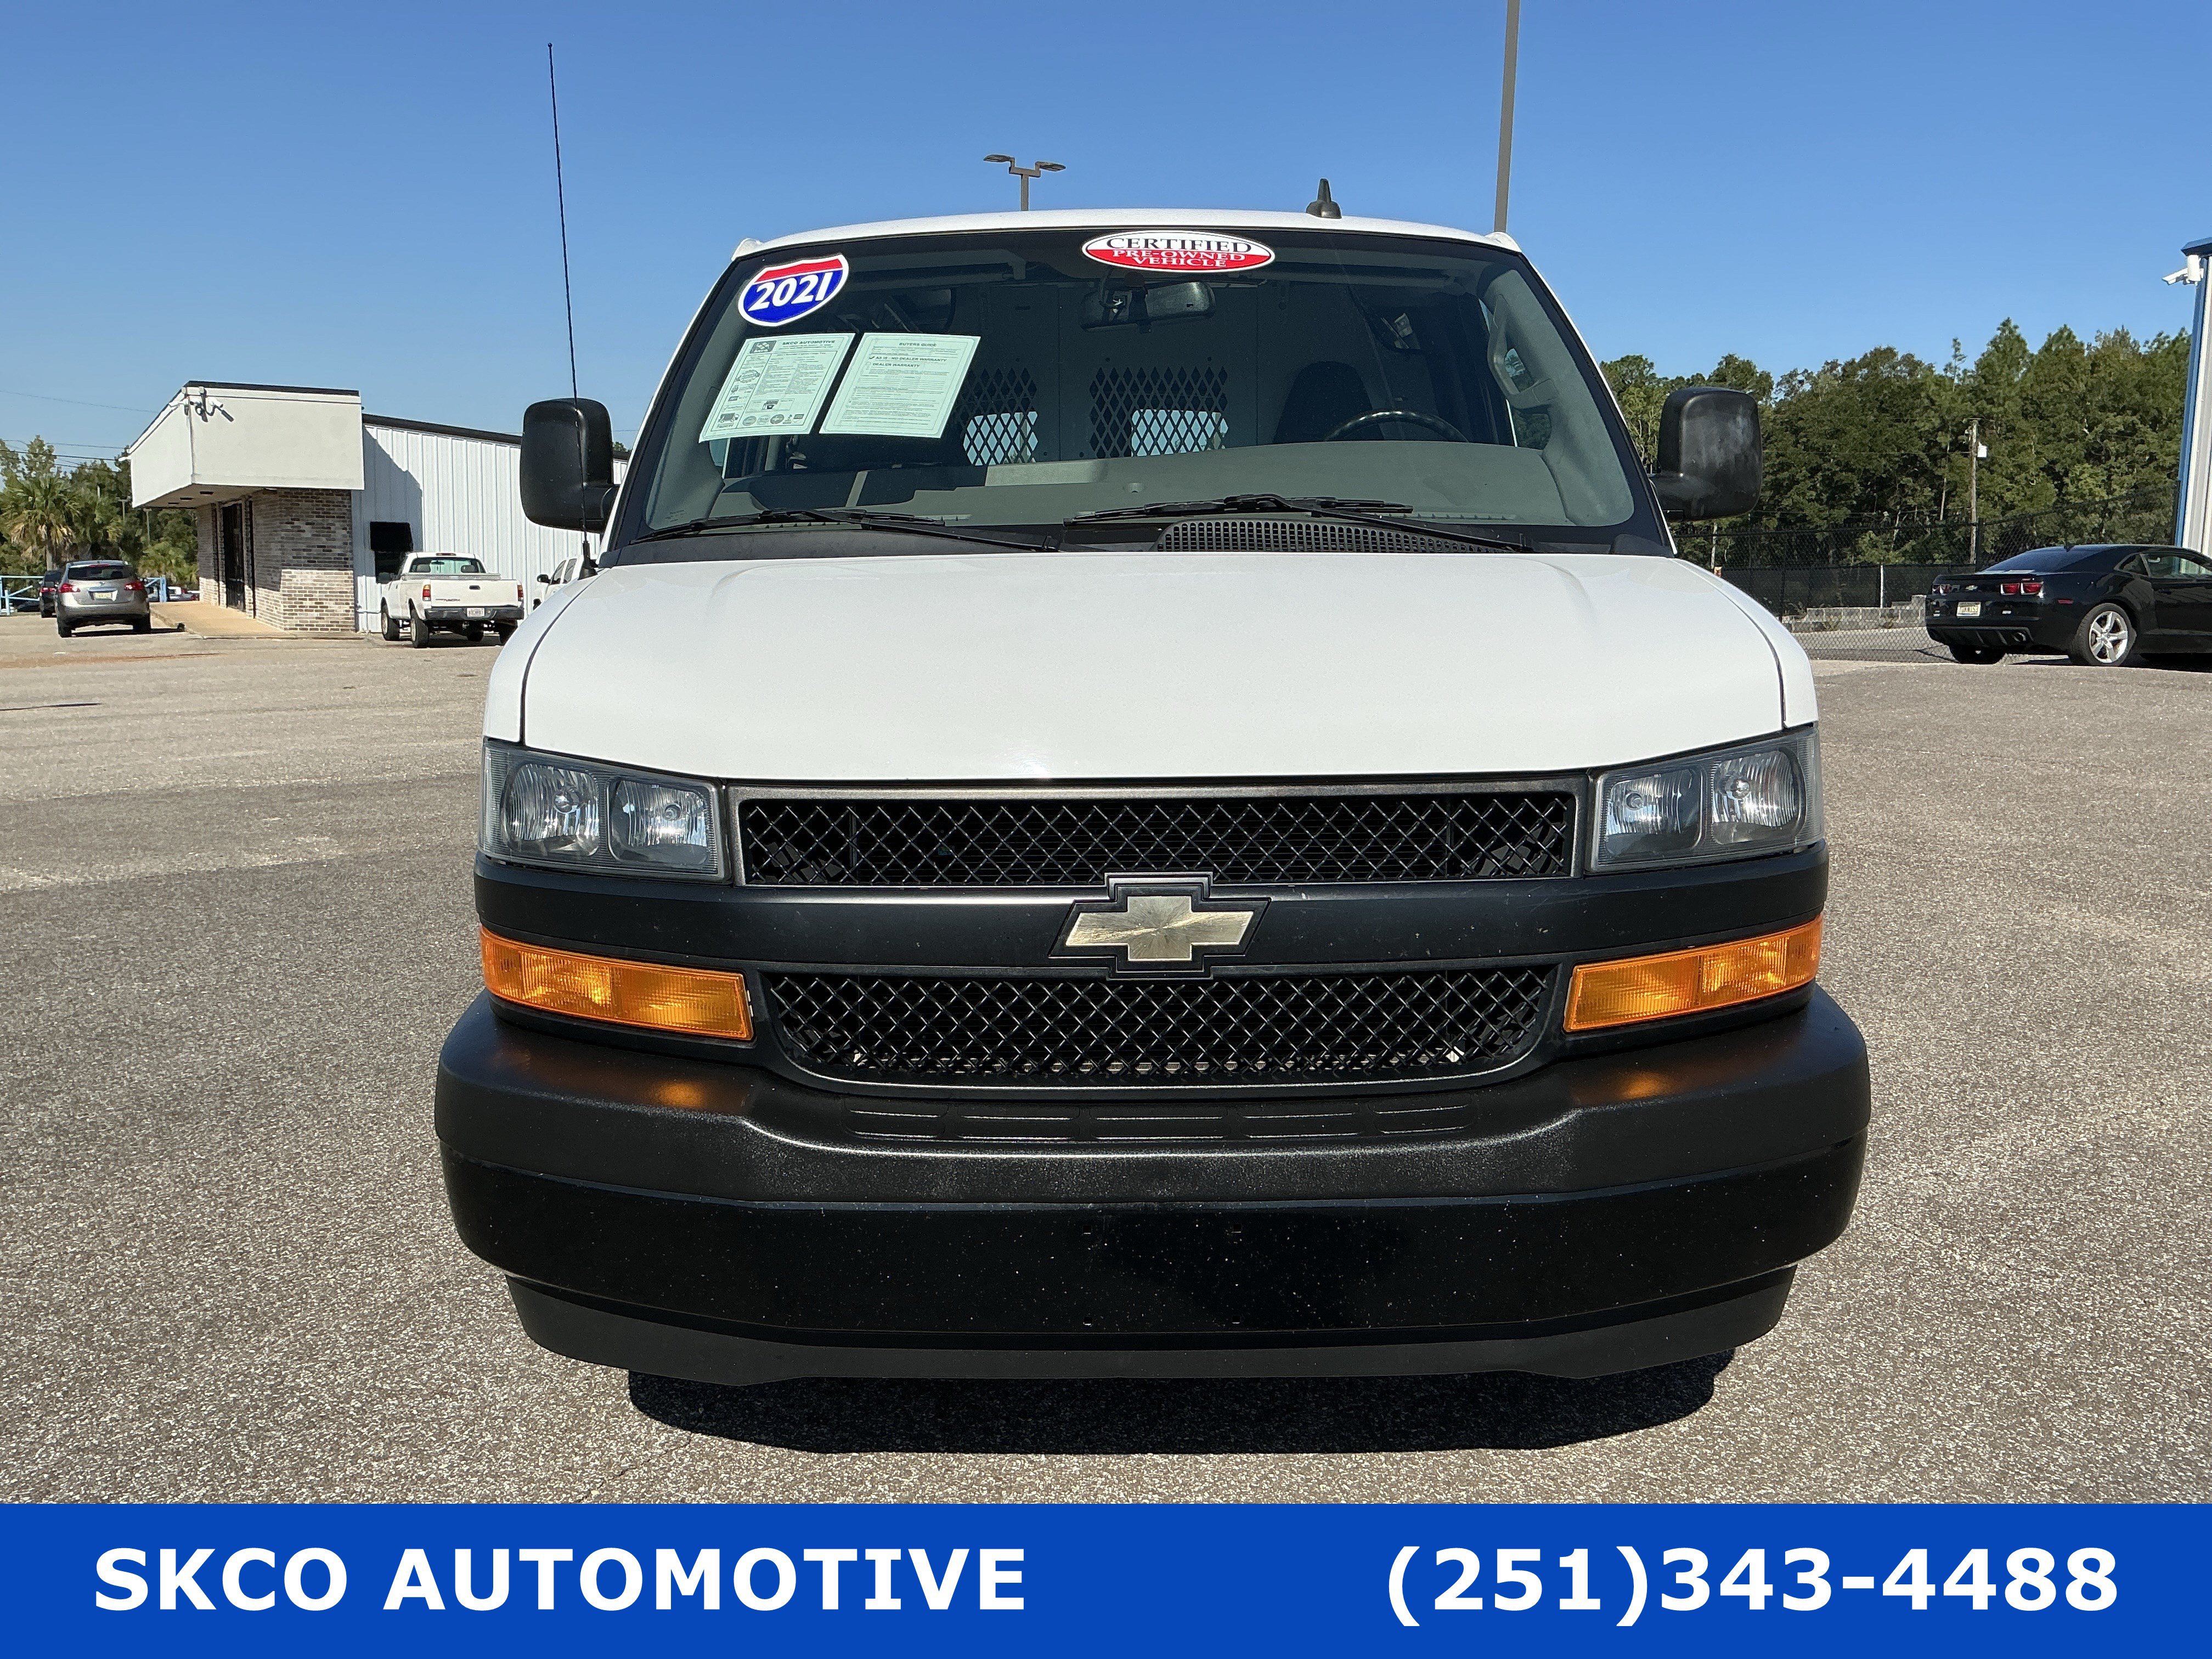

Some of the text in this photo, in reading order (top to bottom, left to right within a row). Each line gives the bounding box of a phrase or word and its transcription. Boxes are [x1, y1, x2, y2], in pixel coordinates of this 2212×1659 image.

[1107, 238, 1251, 253] CERTIFIED
[1112, 250, 1245, 261] PRE-OWNED
[1132, 257, 1227, 267] VEHICLE
[747, 272, 833, 312] 2021
